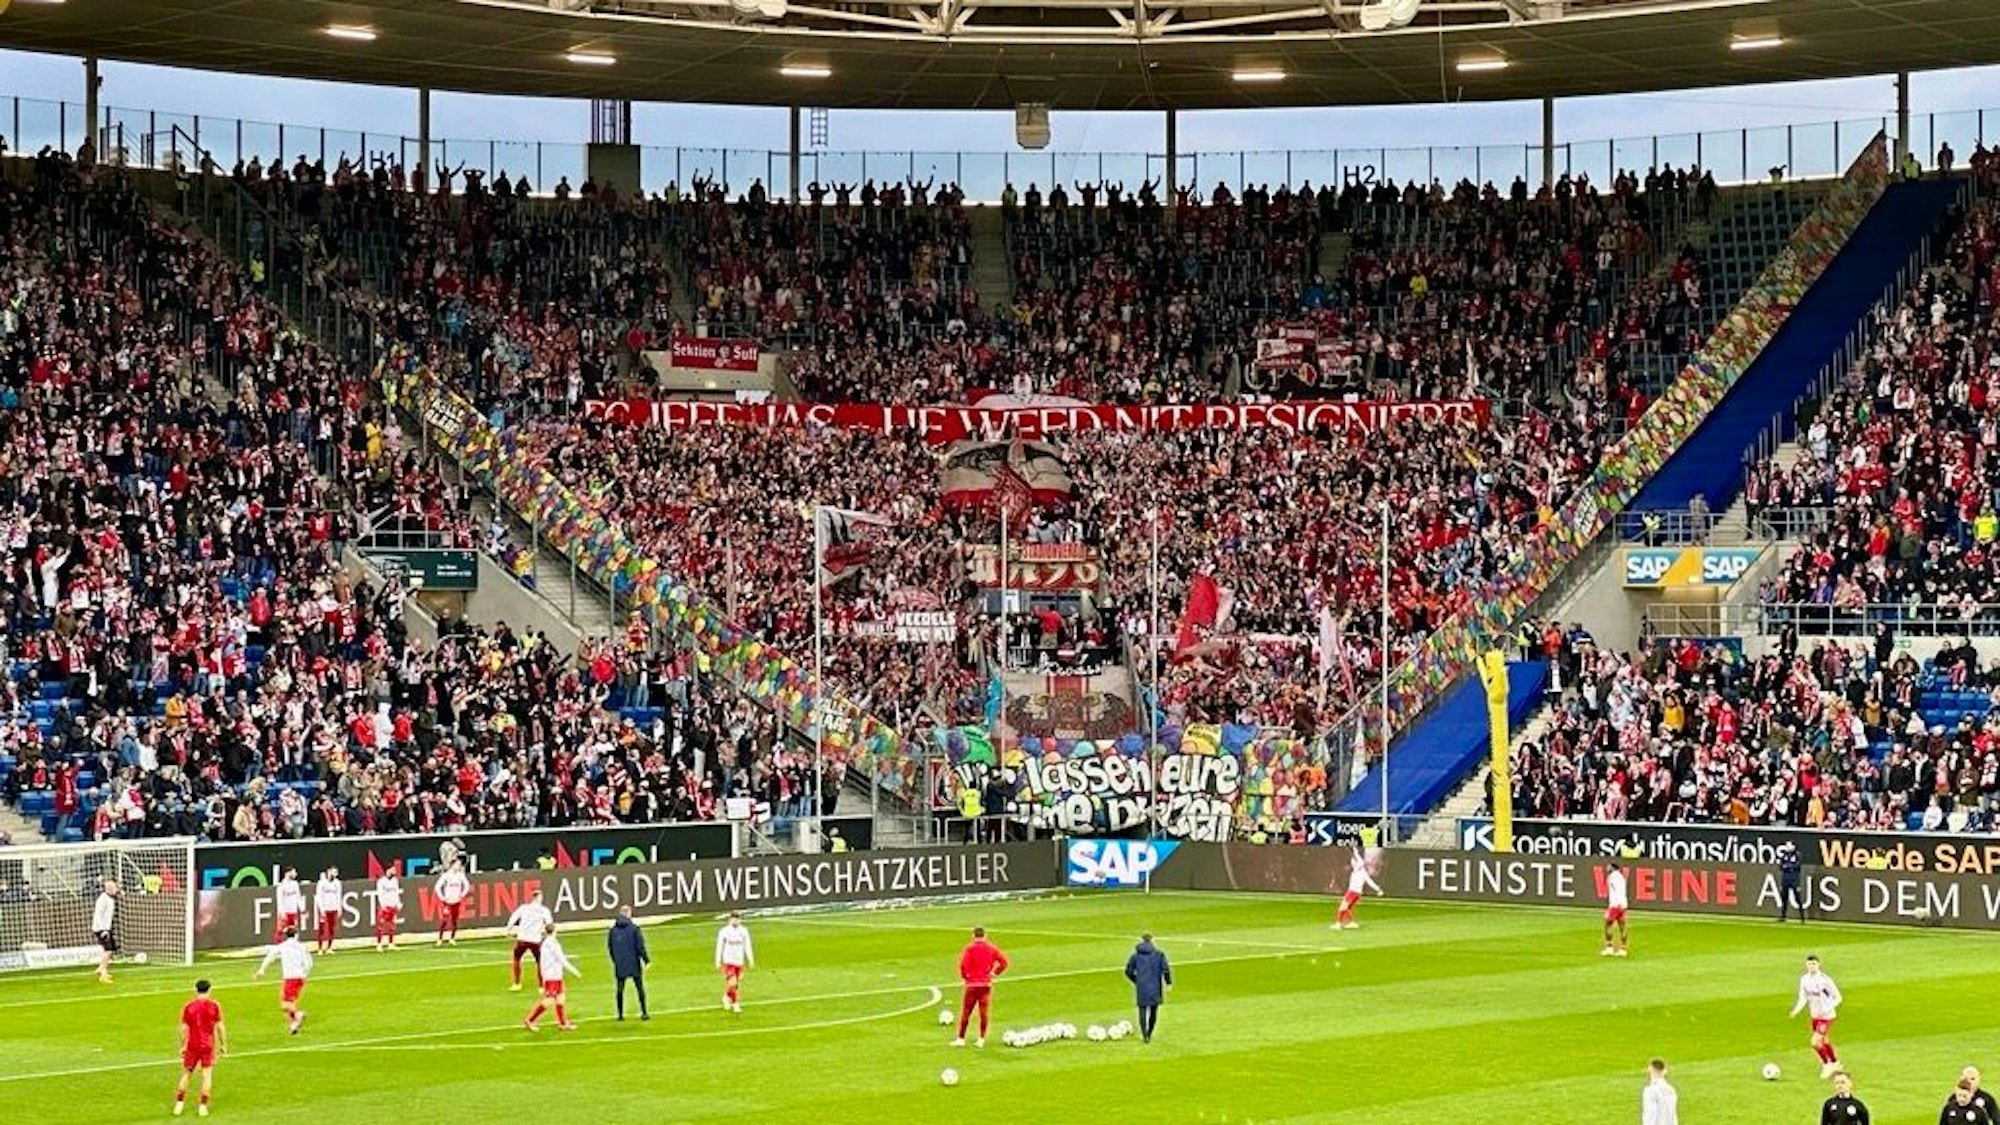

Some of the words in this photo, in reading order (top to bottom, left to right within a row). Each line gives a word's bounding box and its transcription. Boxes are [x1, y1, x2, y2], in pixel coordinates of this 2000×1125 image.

[1344, 165, 1376, 184] H2
[673, 340, 716, 358] Sektion
[1627, 556, 1671, 579] SAP
[1703, 556, 1749, 579] SAP
[1023, 755, 1151, 796] lassen
[1161, 754, 1240, 795] eure
[1069, 841, 1159, 886] SAP
[554, 875, 619, 913] AUS
[633, 870, 704, 908] DEM
[714, 851, 1010, 902] WEINSCHATZKELLER
[1418, 857, 1576, 898] FEINSTE
[1863, 877, 1961, 919] DEM
